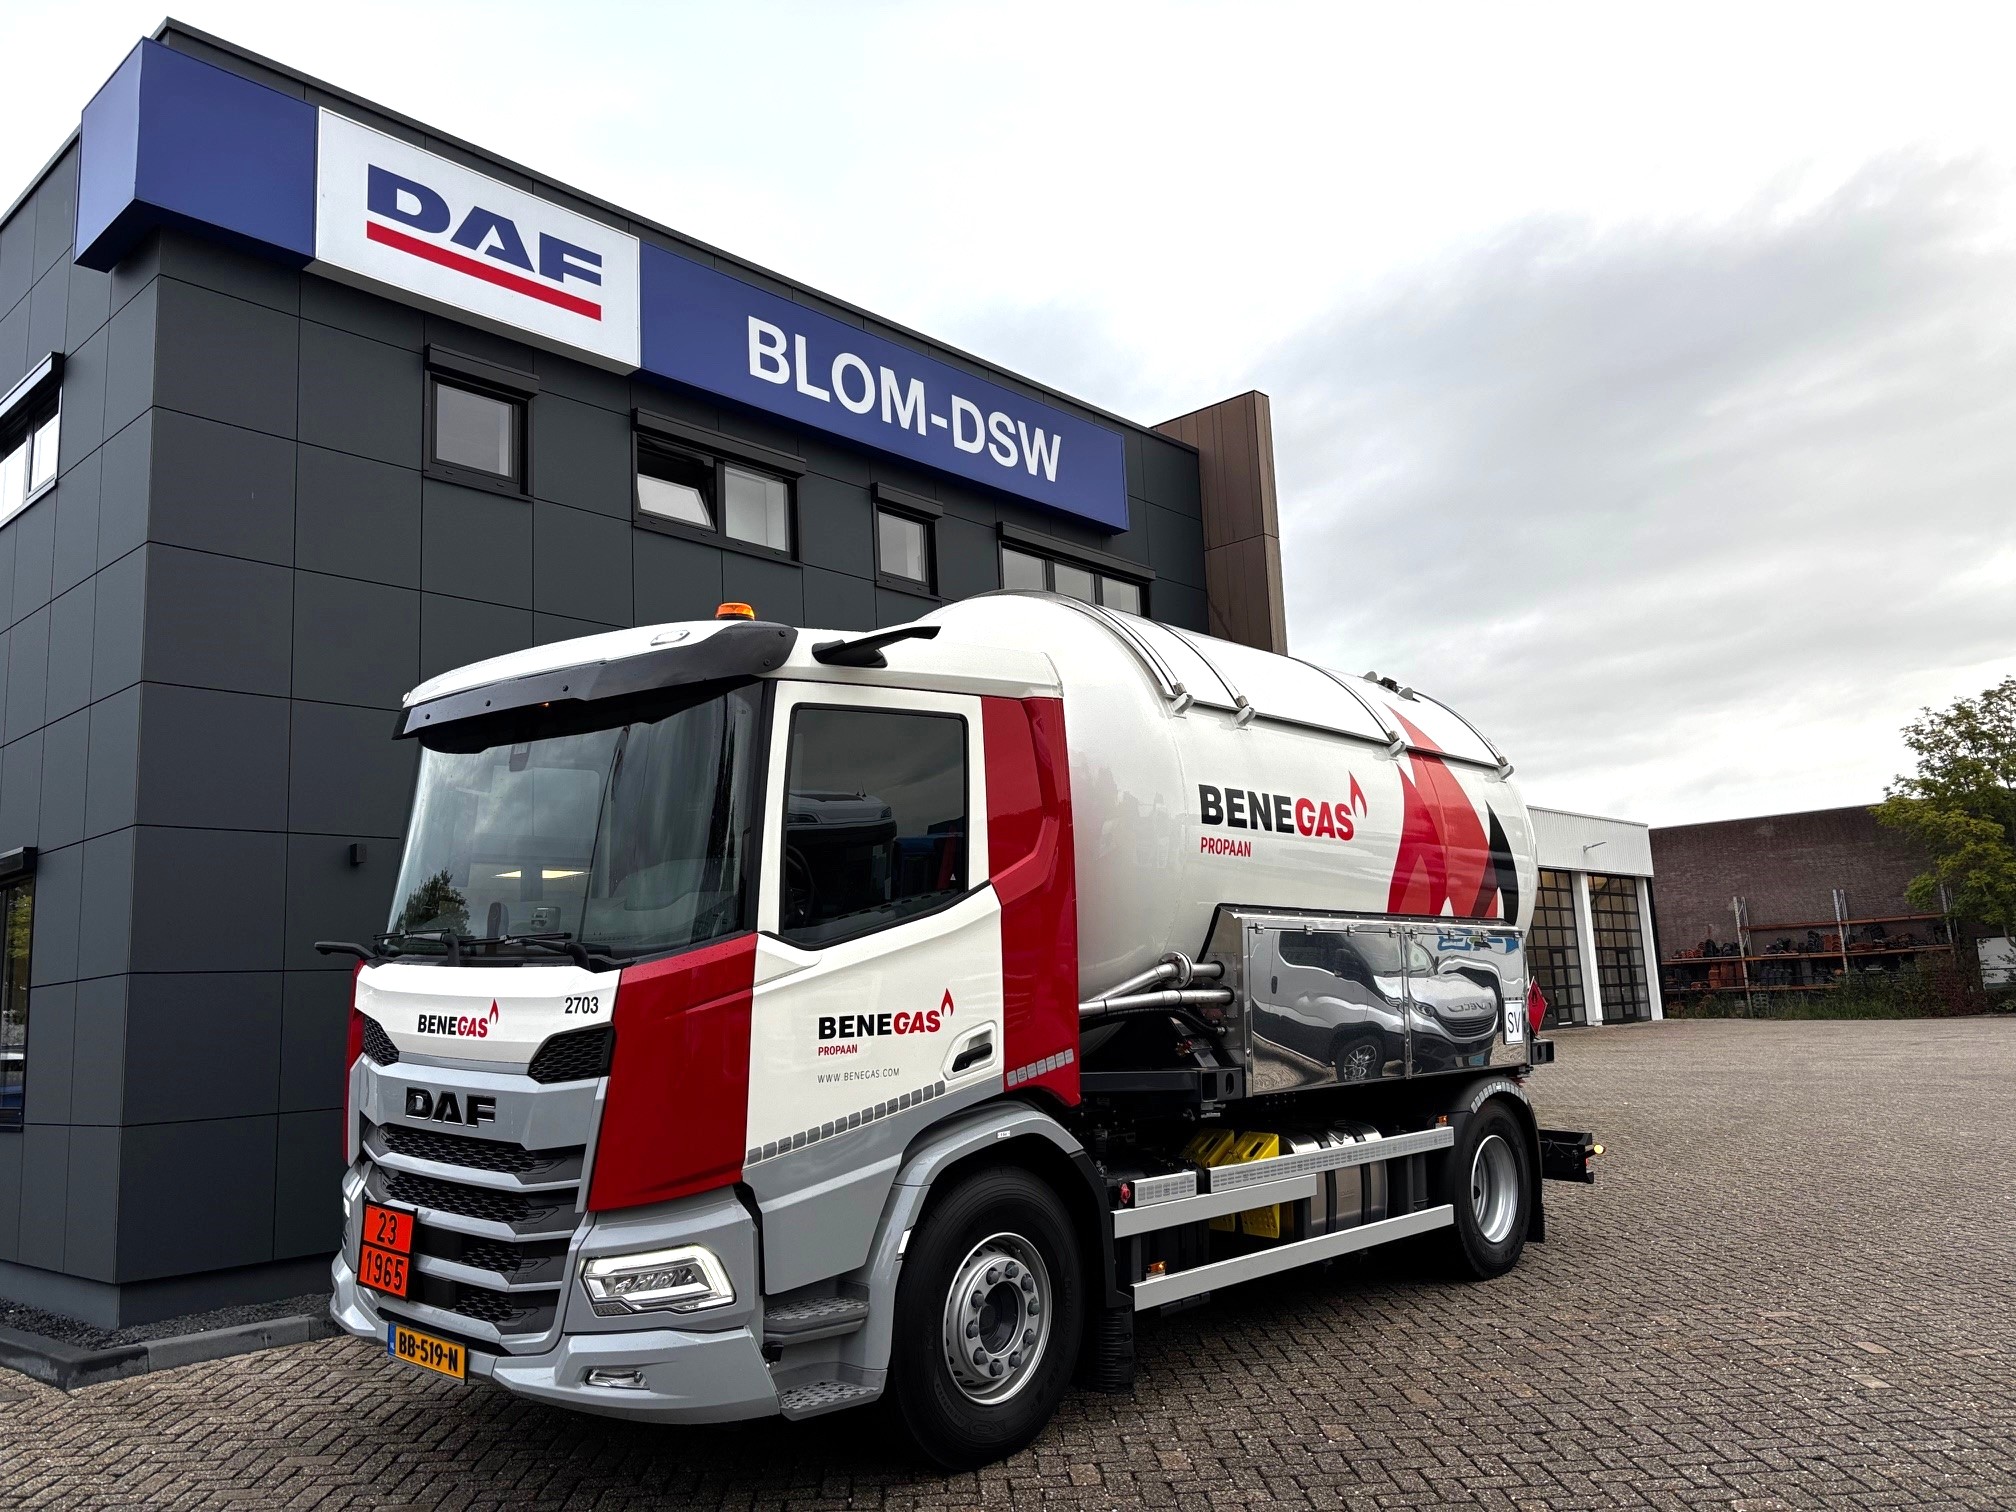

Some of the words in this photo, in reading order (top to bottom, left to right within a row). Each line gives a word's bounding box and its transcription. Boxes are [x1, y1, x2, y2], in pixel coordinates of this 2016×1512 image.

[367, 163, 602, 287] DAF
[747, 315, 1062, 482] BLOM-DSW
[1198, 784, 1355, 841] BENEGAS
[1200, 837, 1252, 858] PROPAAN
[564, 996, 599, 1015] 2703
[417, 1014, 489, 1038] BENEGAS
[818, 1010, 941, 1040] BENEGAS
[1507, 1011, 1521, 1034] SV
[818, 1044, 858, 1056] PROPAAN
[817, 1067, 900, 1083] WWW.BENEGAS.COM
[405, 1086, 498, 1128] DAF
[377, 1211, 398, 1245] 23
[366, 1250, 404, 1291] 1965
[399, 1331, 458, 1373] BB-519-N
